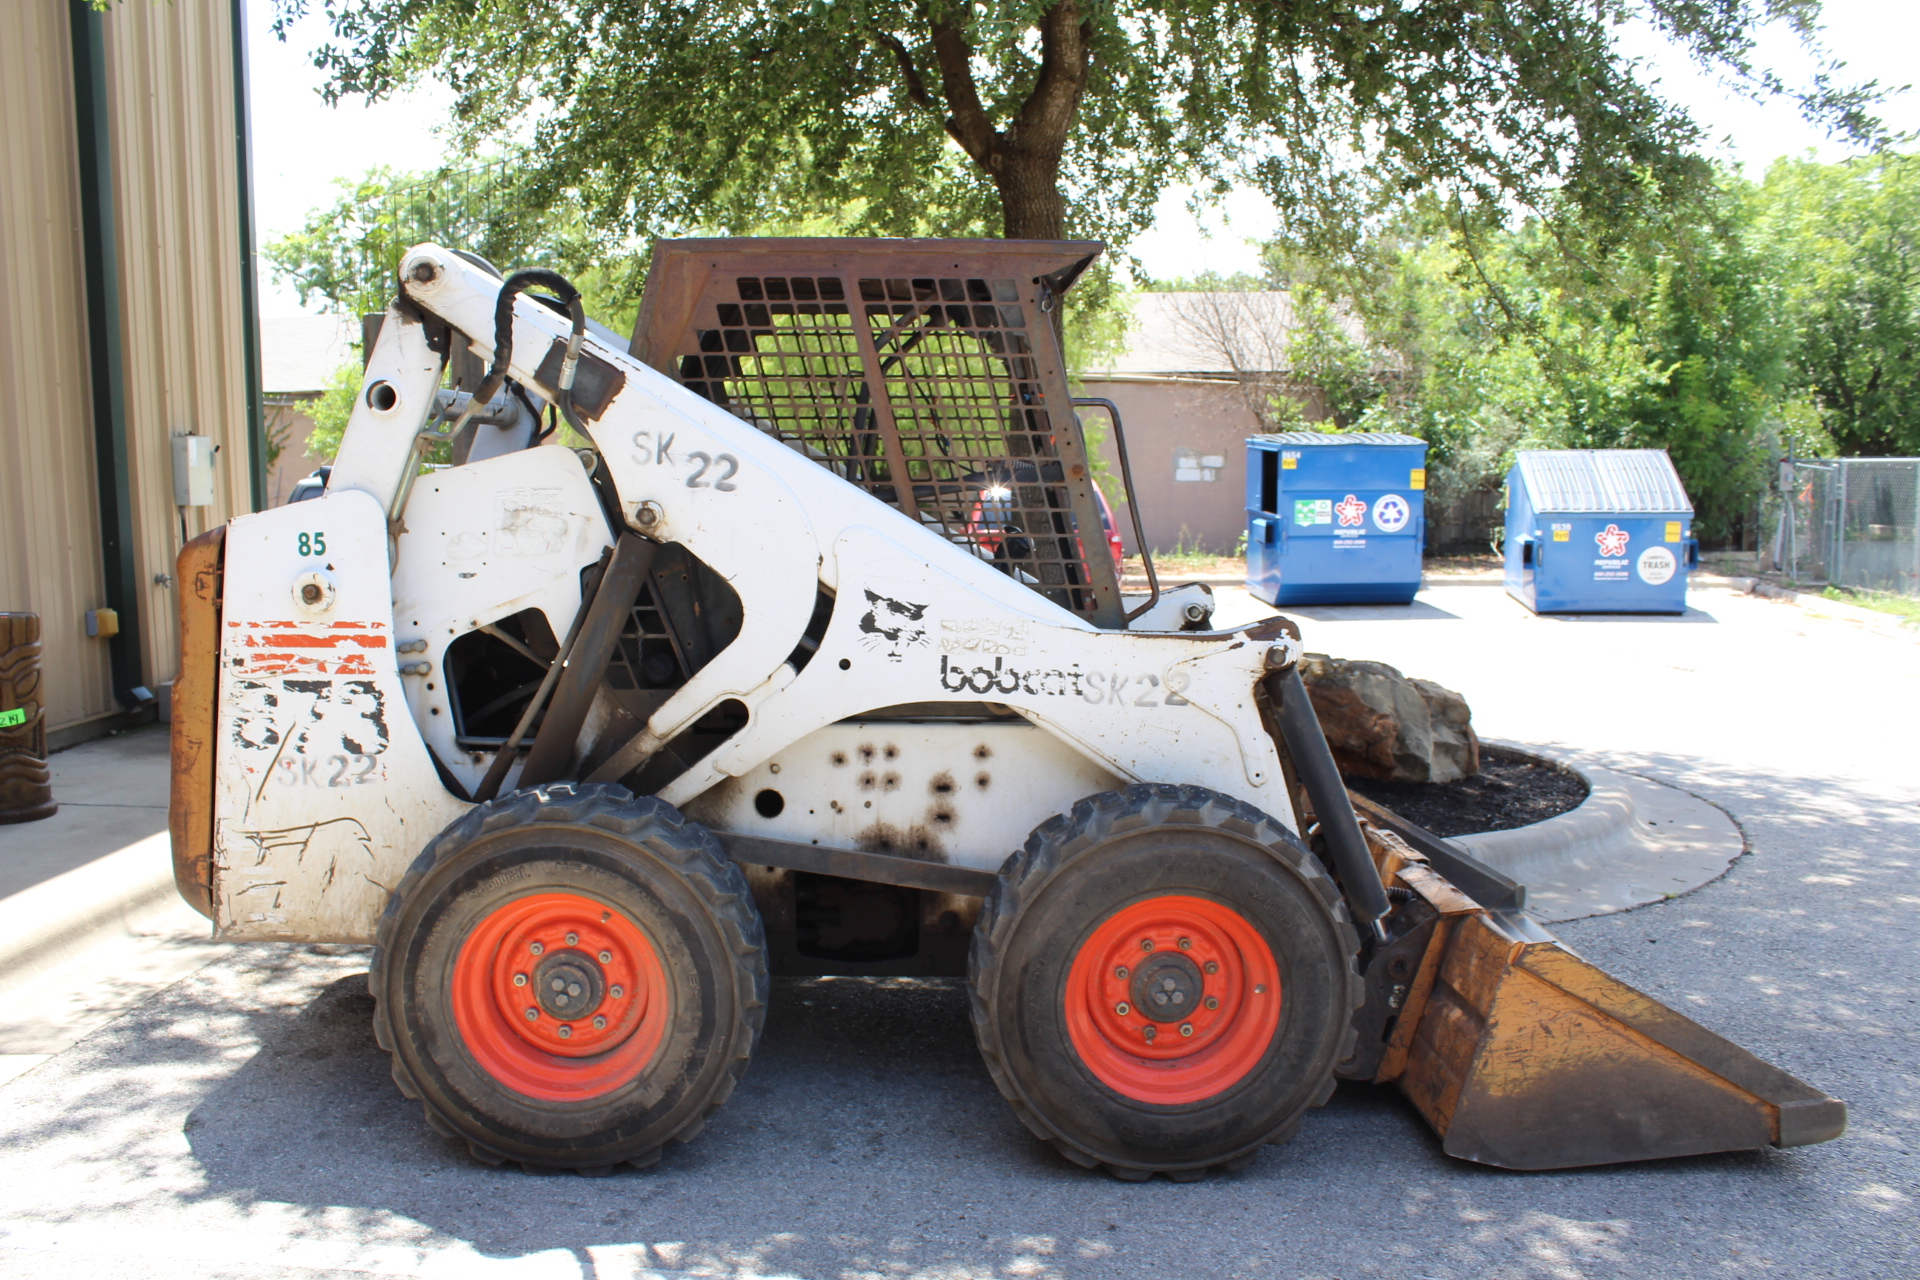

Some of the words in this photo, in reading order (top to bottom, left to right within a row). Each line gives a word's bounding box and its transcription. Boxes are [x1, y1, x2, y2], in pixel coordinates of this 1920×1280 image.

[631, 430, 675, 466] SK
[686, 450, 739, 492] 22
[297, 531, 327, 557] 85
[1643, 561, 1670, 569] TRASH
[940, 655, 1083, 696] bobcat
